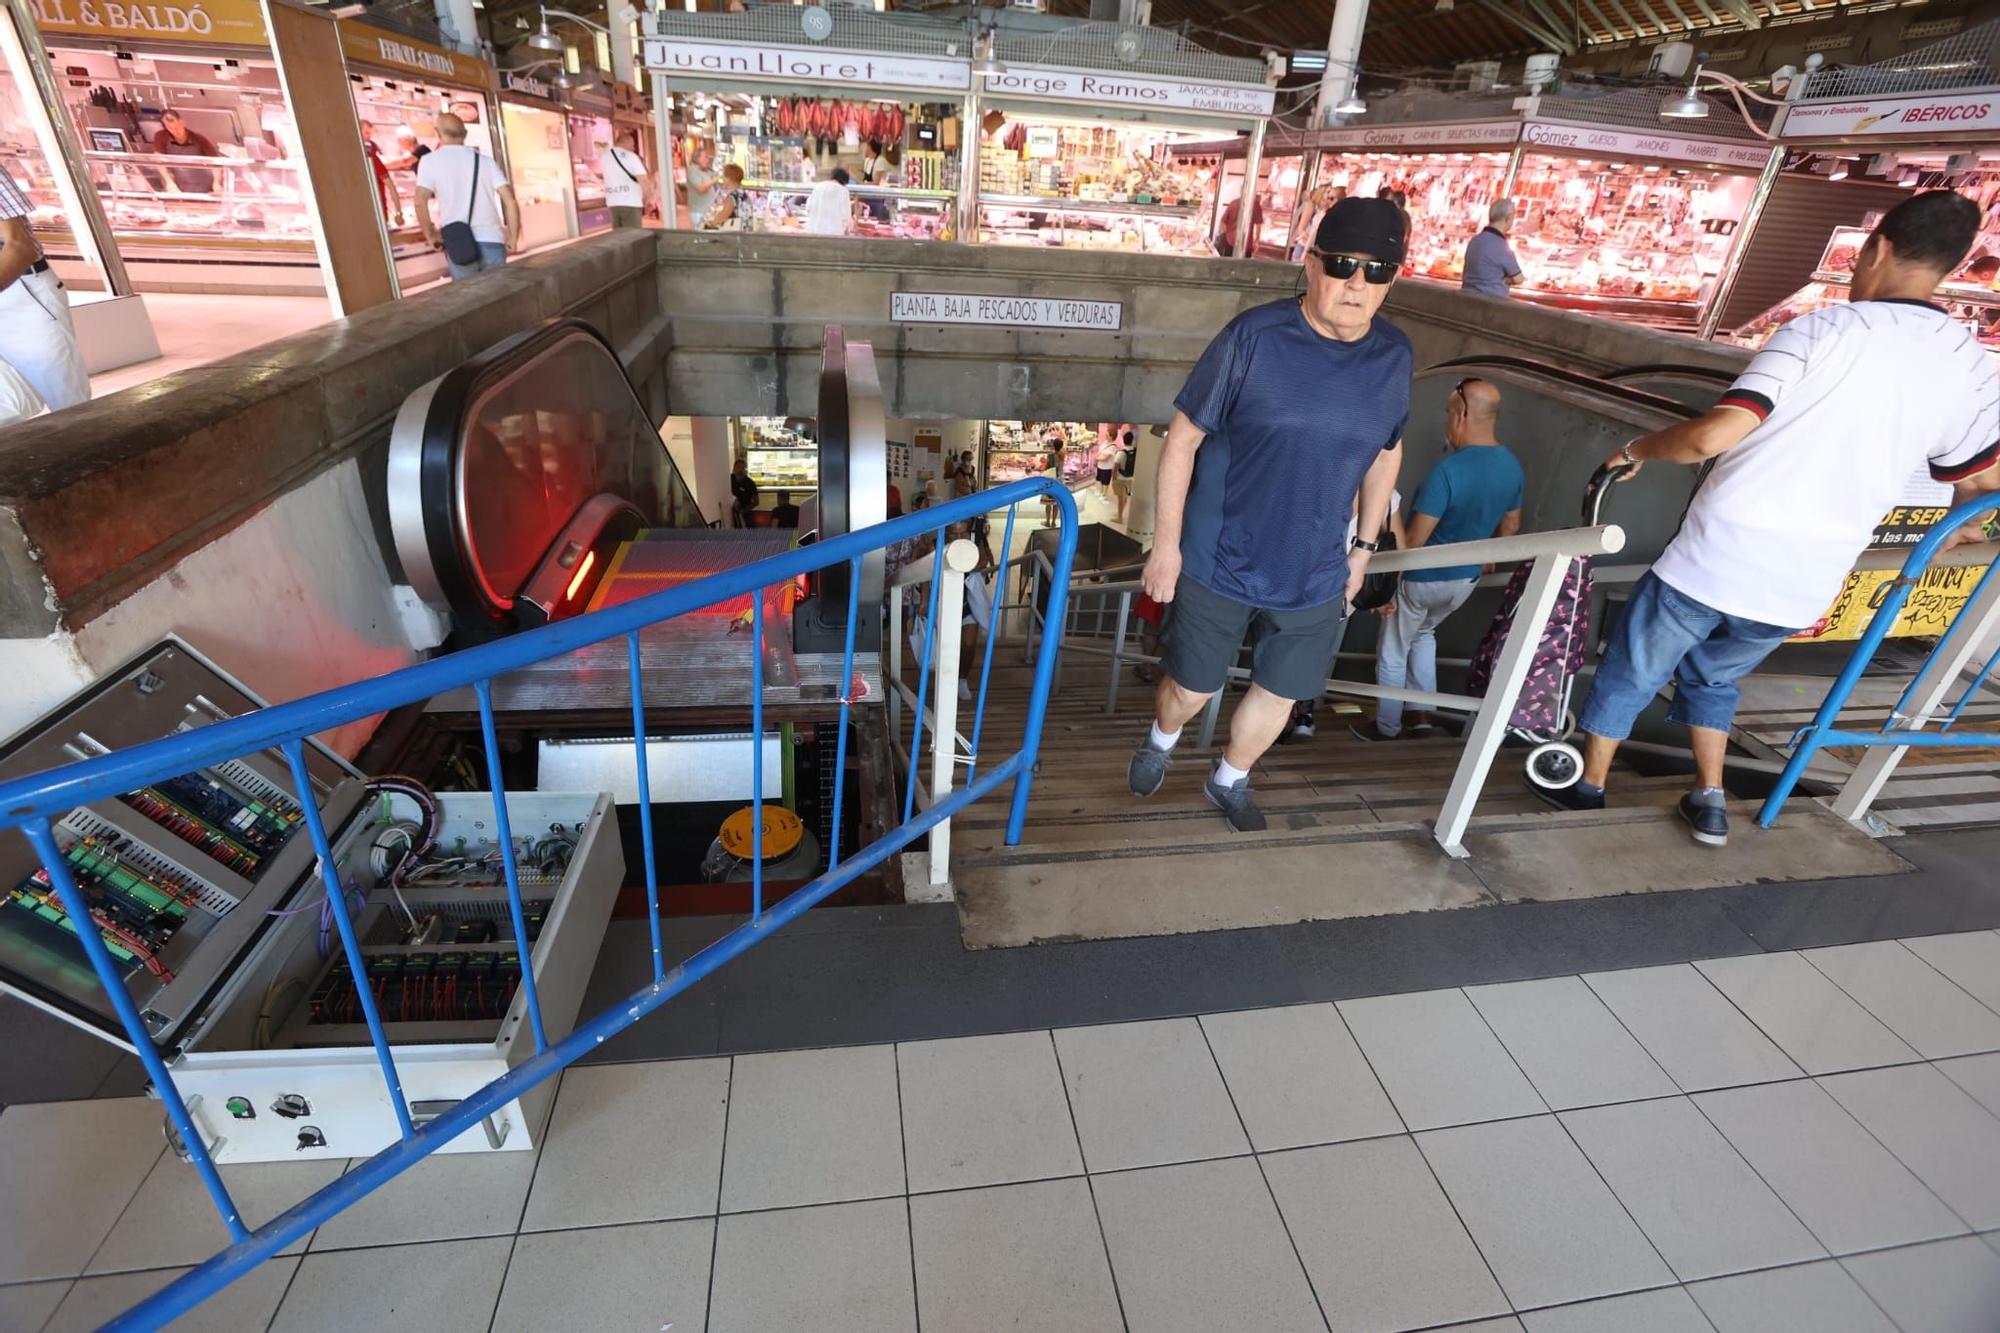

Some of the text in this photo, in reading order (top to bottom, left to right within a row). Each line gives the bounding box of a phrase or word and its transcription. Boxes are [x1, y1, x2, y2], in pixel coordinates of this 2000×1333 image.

[79, 0, 103, 27] &
[107, 3, 212, 34] BALDÓ
[1122, 40, 1136, 51] 99
[990, 74, 1239, 100] Jorge Ramos JAMONES
[1192, 98, 1263, 112] EMBUTIDOS
[1901, 103, 1991, 123] IBÉRICOS
[1363, 130, 1405, 145] Gómez
[1527, 124, 1577, 147] Gómez
[1588, 135, 1618, 147] QUESOS
[1635, 140, 1671, 153] JAMONES
[894, 295, 1113, 325] PLANTA BAJA PESCADOS Y VERDURAS
[1881, 531, 1902, 544] las
[1904, 533, 1925, 543] mo
